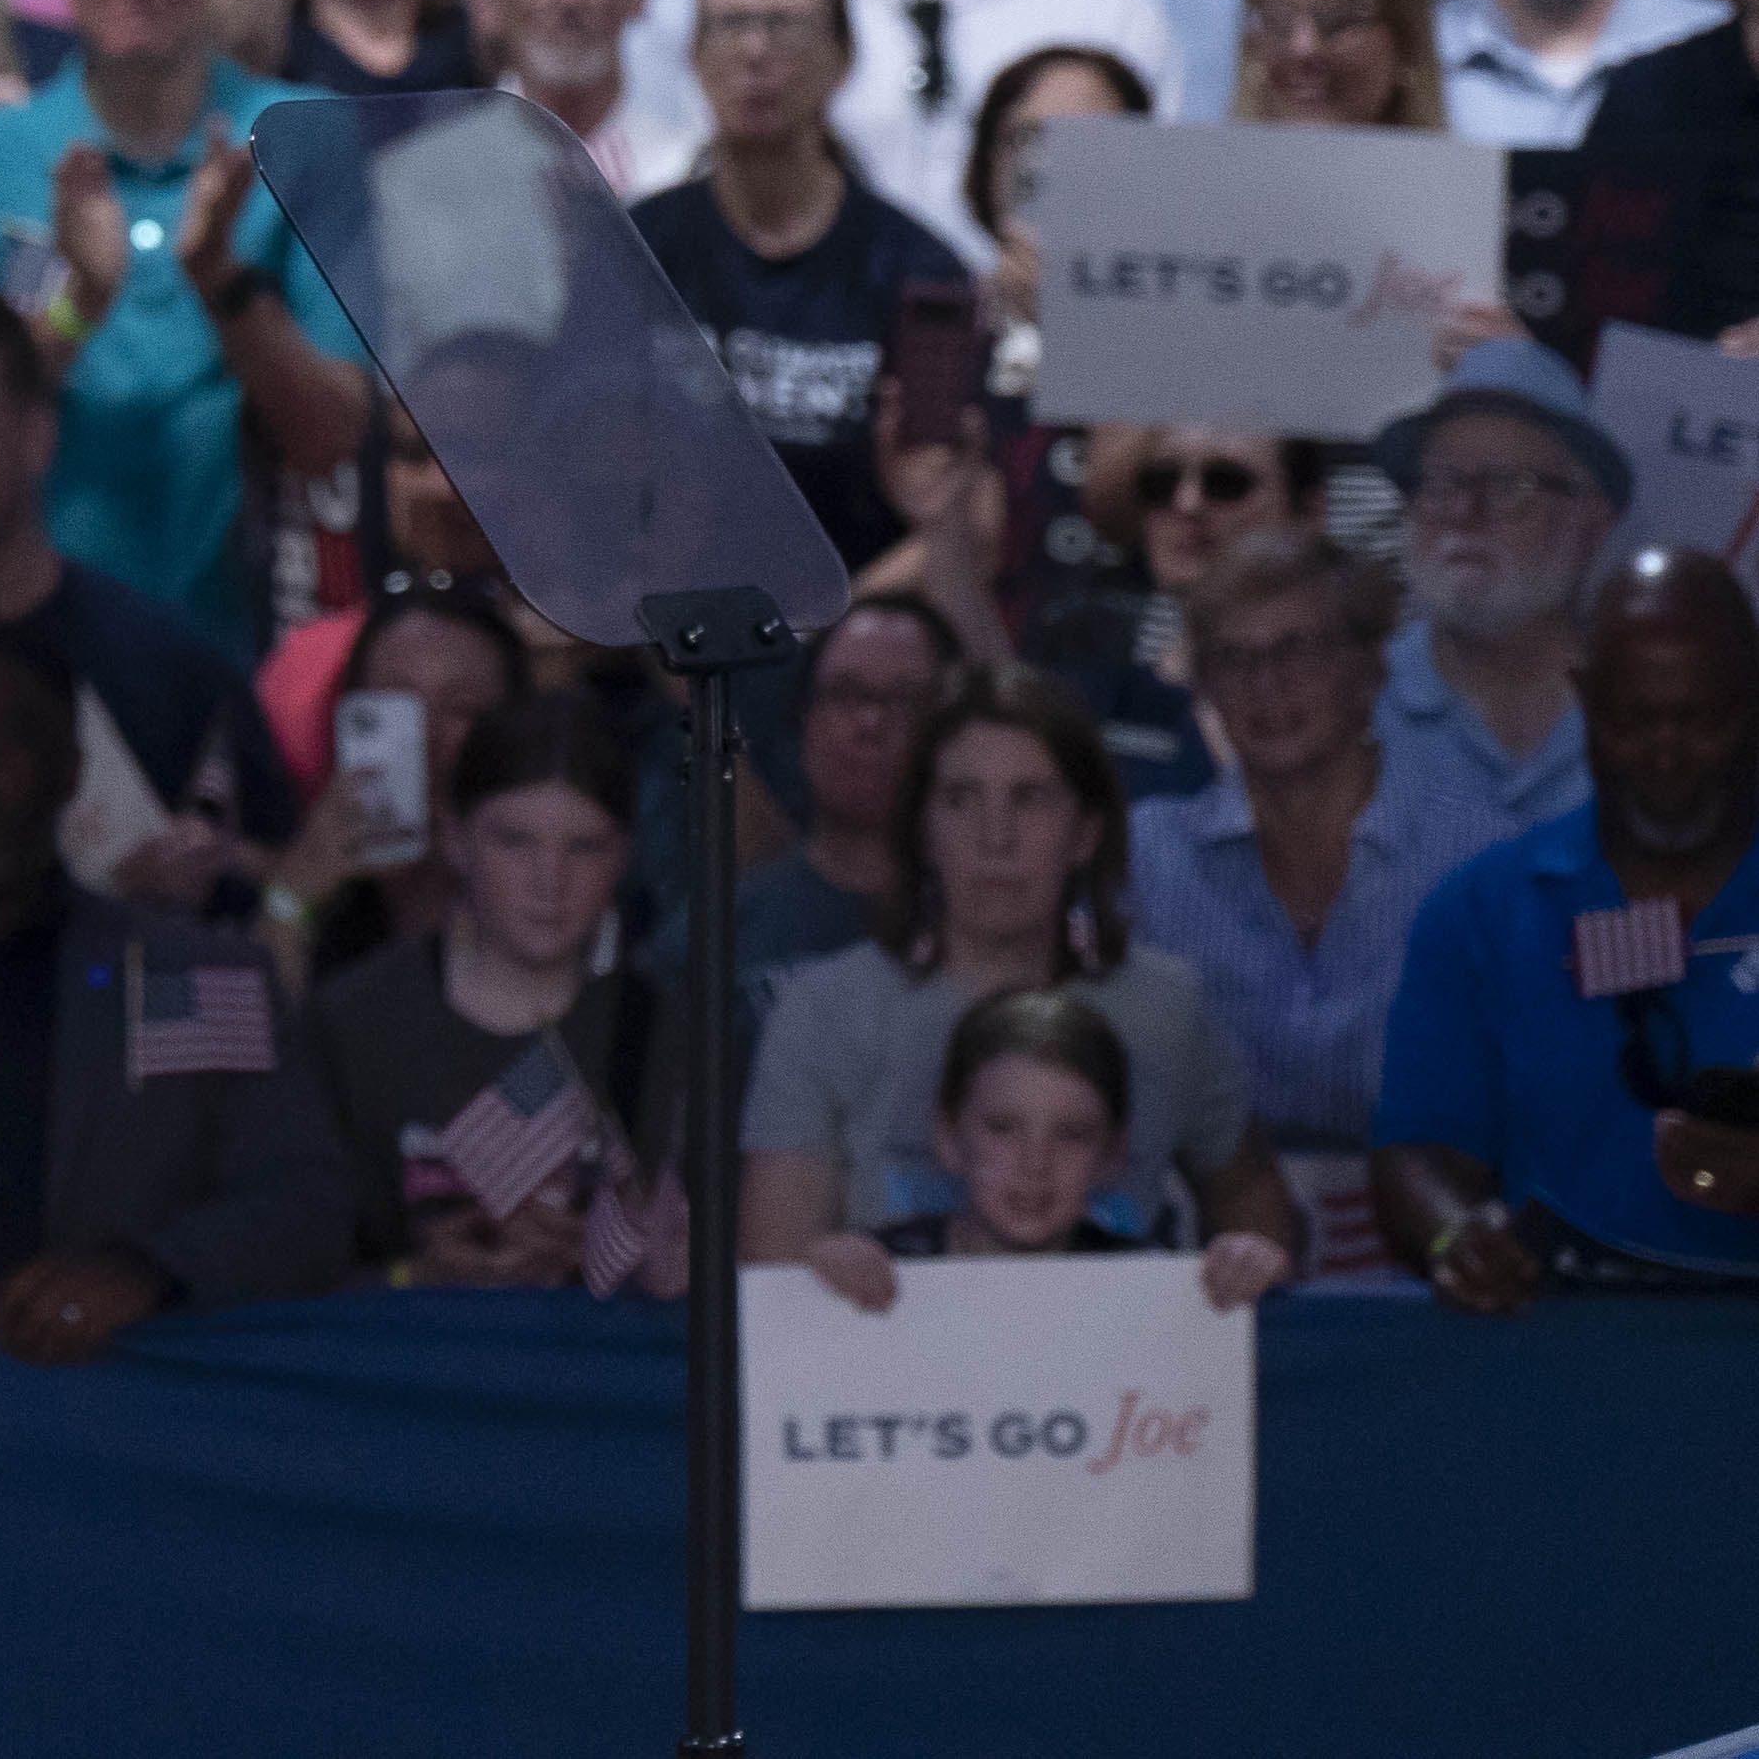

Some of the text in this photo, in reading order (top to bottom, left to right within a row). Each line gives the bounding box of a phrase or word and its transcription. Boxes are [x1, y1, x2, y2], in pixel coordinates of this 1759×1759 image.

[1069, 249, 1469, 325] LET'S GO Joe
[781, 1388, 1212, 1476] LET'S GO Joe
